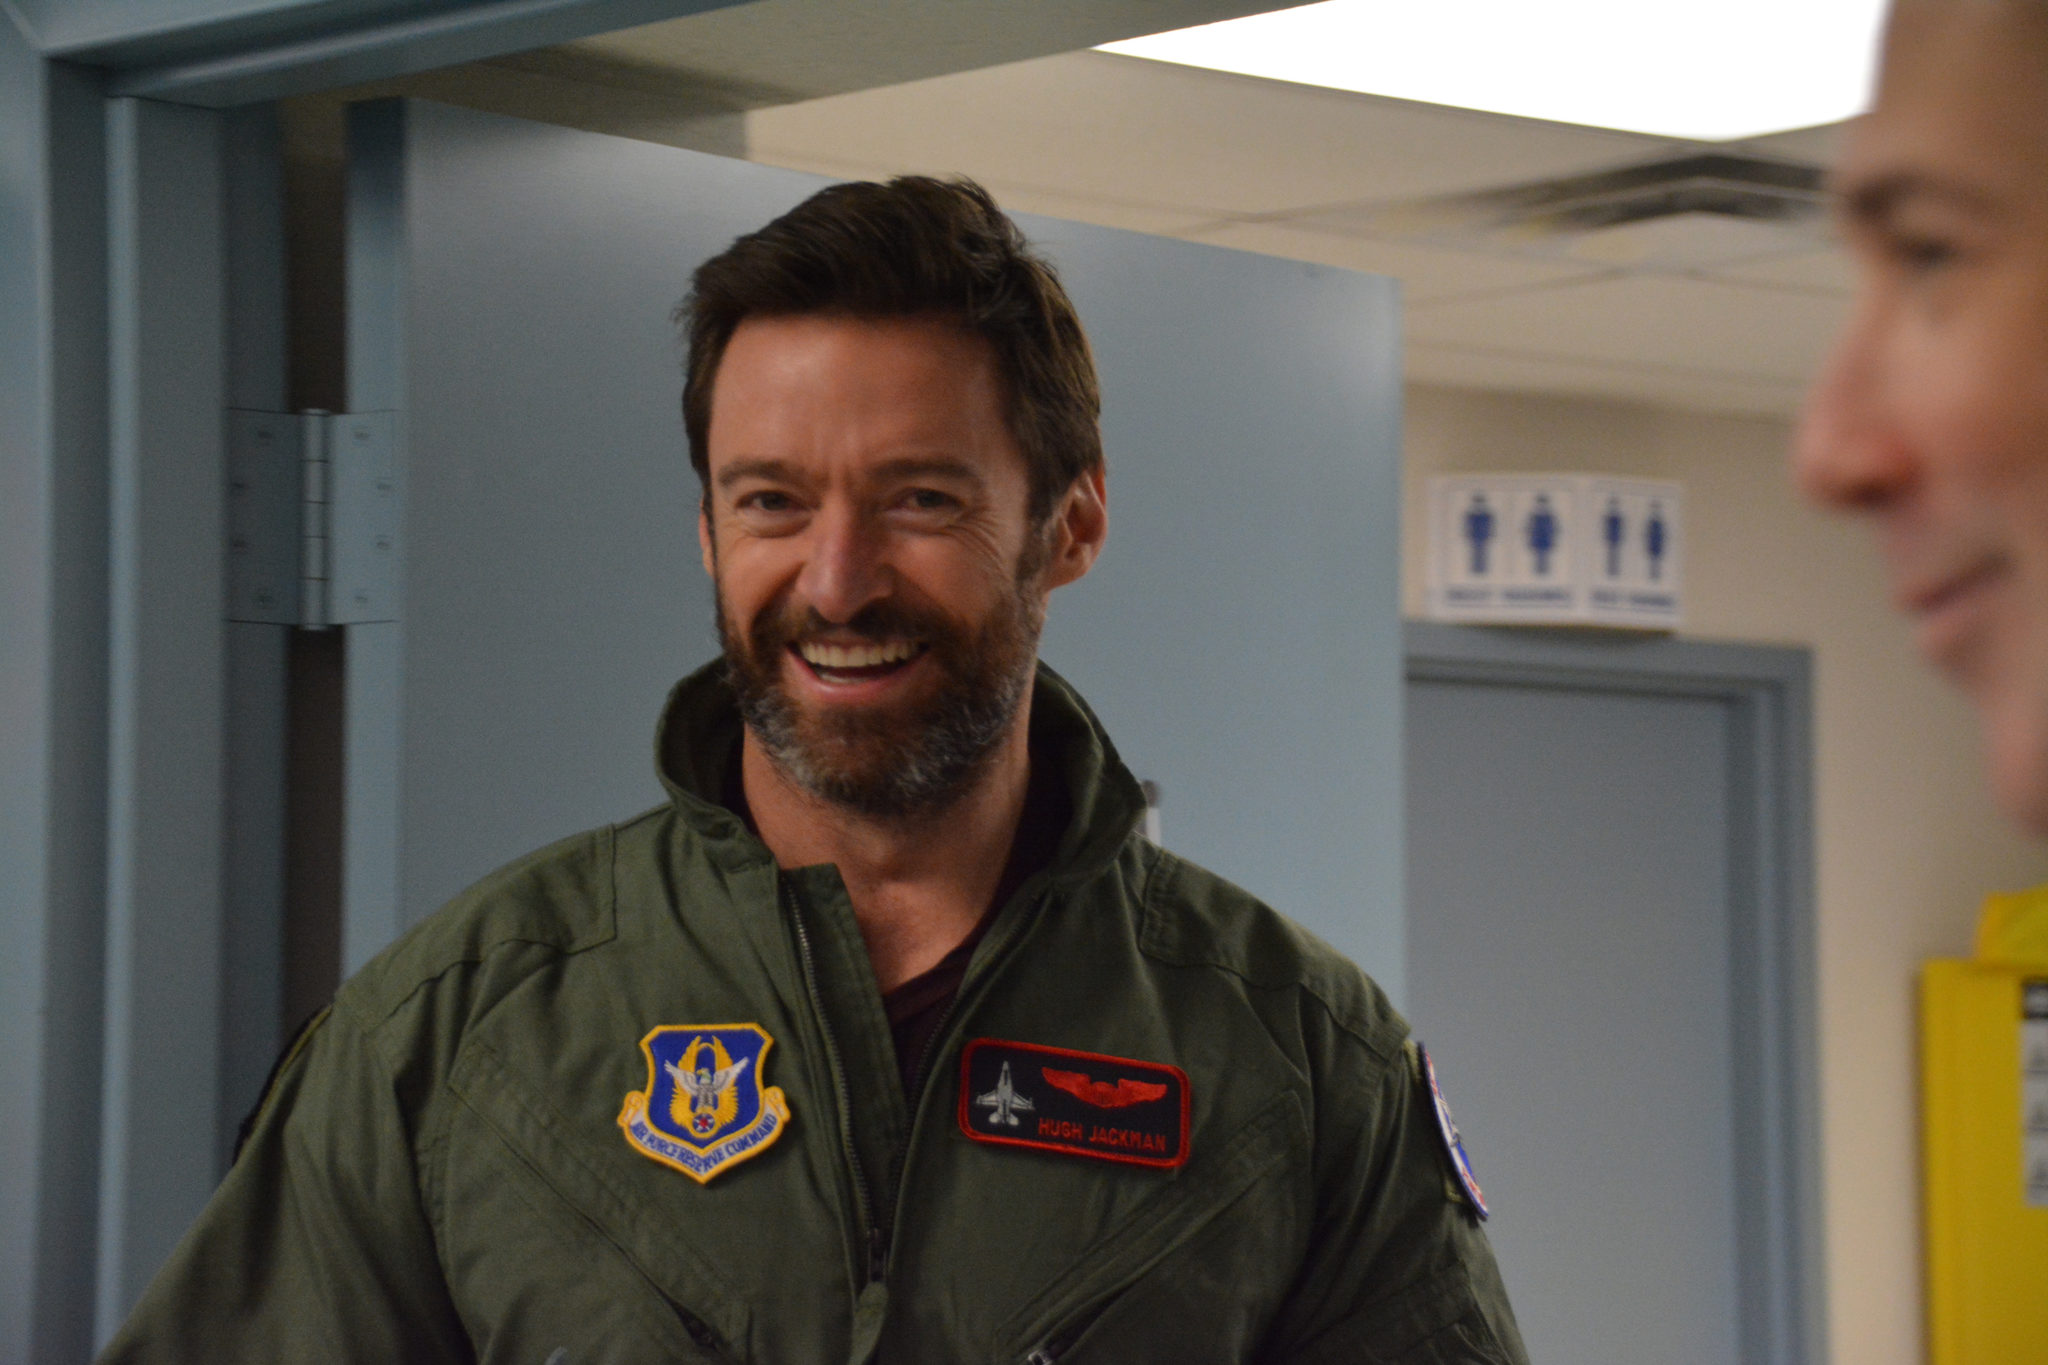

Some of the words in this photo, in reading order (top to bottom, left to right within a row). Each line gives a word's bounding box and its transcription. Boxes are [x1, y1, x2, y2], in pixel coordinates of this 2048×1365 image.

[643, 1133, 677, 1157] FORCE
[676, 1147, 725, 1173] RESERVE
[724, 1113, 778, 1155] COMMAND
[1038, 1117, 1083, 1141] HUGH
[1089, 1126, 1166, 1152] JACKMAN
